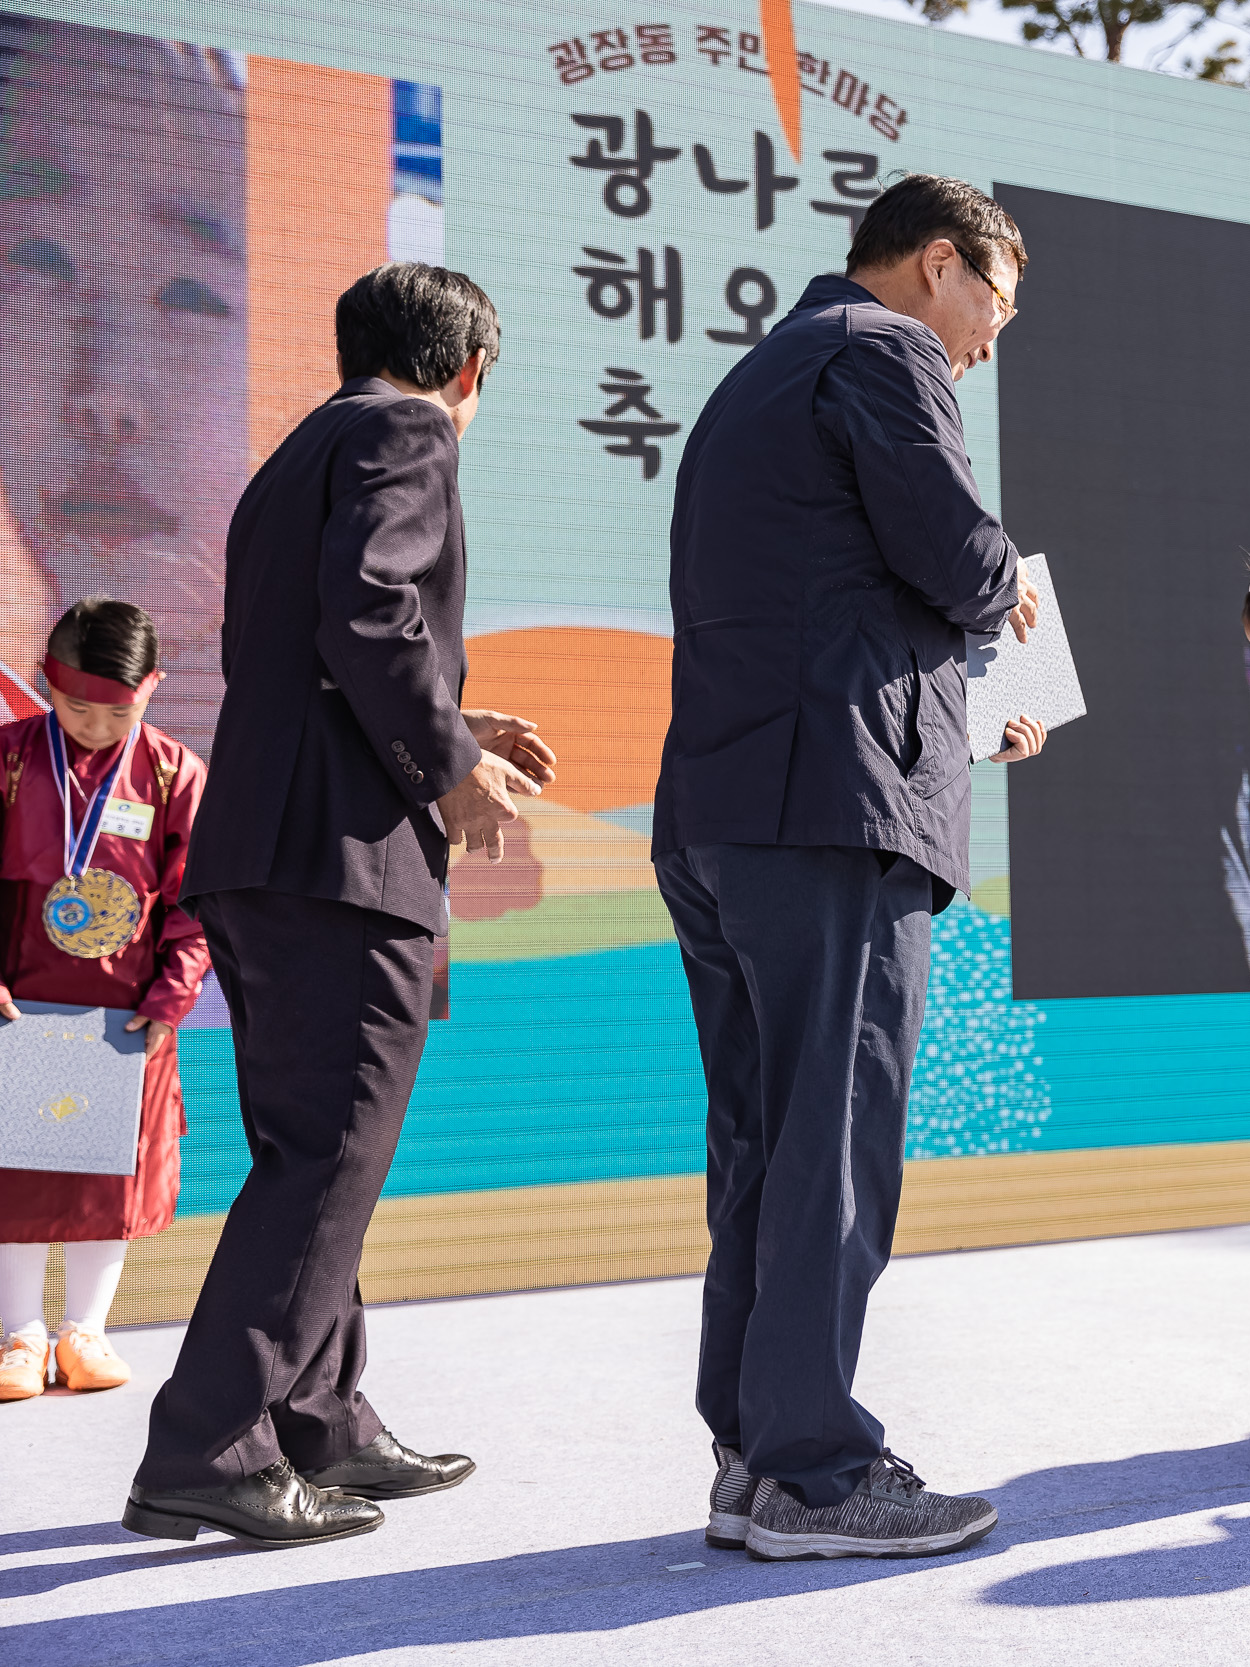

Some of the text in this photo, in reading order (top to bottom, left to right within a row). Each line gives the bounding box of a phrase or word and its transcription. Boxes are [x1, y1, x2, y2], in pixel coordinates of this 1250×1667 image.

[547, 23, 676, 86] 광장동
[797, 52, 907, 142] 한마당
[569, 109, 879, 238] 광나루
